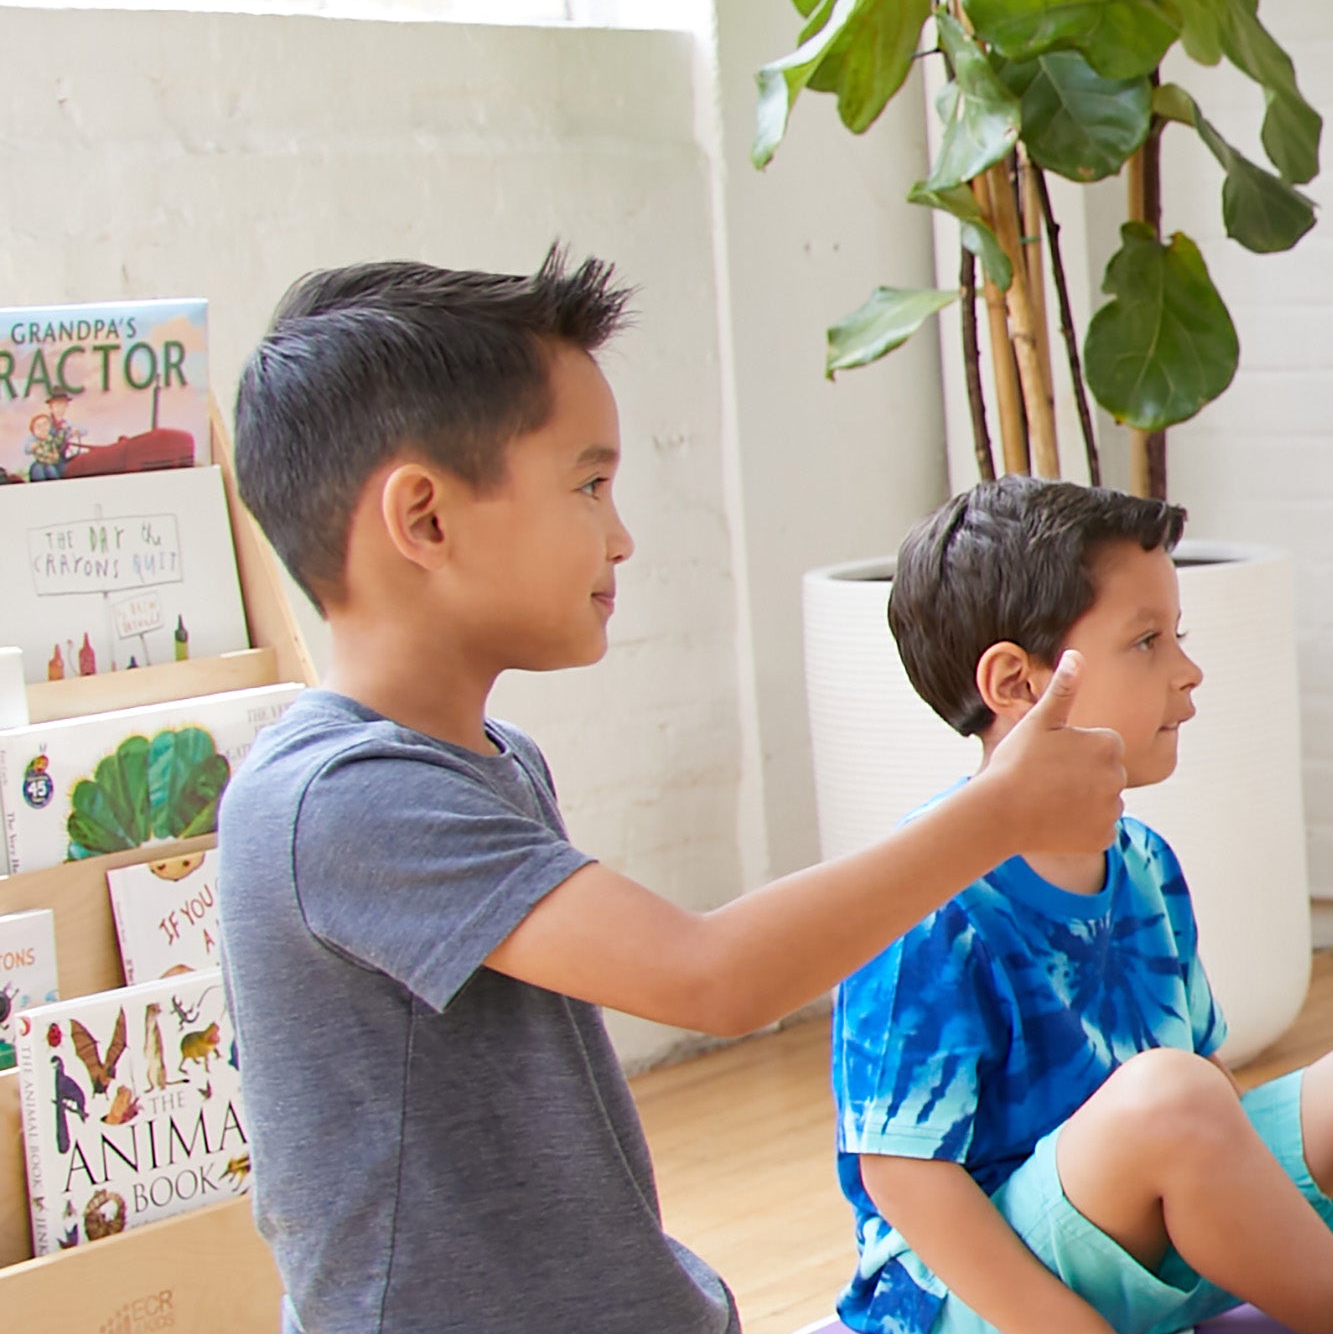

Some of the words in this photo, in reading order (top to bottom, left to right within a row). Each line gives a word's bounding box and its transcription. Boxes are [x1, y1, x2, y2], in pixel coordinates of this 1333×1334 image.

[11, 317, 137, 345] GRANDPA'S
[45, 530, 73, 550] THE
[89, 526, 124, 552] DAY
[34, 552, 119, 579] CRAYONS
[133, 551, 177, 583] QUIT
[27, 780, 48, 799] 45
[159, 911, 180, 945] IF
[180, 884, 214, 925] YOU
[203, 929, 215, 954] A
[0, 947, 35, 970] ONS
[20, 1045, 34, 1074] THE
[150, 1091, 186, 1114] THE
[61, 1099, 249, 1194] ANIMA
[29, 1145, 43, 1188] BOOK
[133, 1162, 219, 1213] BOOK
[35, 1218, 48, 1257] JENK
[132, 1289, 173, 1321] ECR
